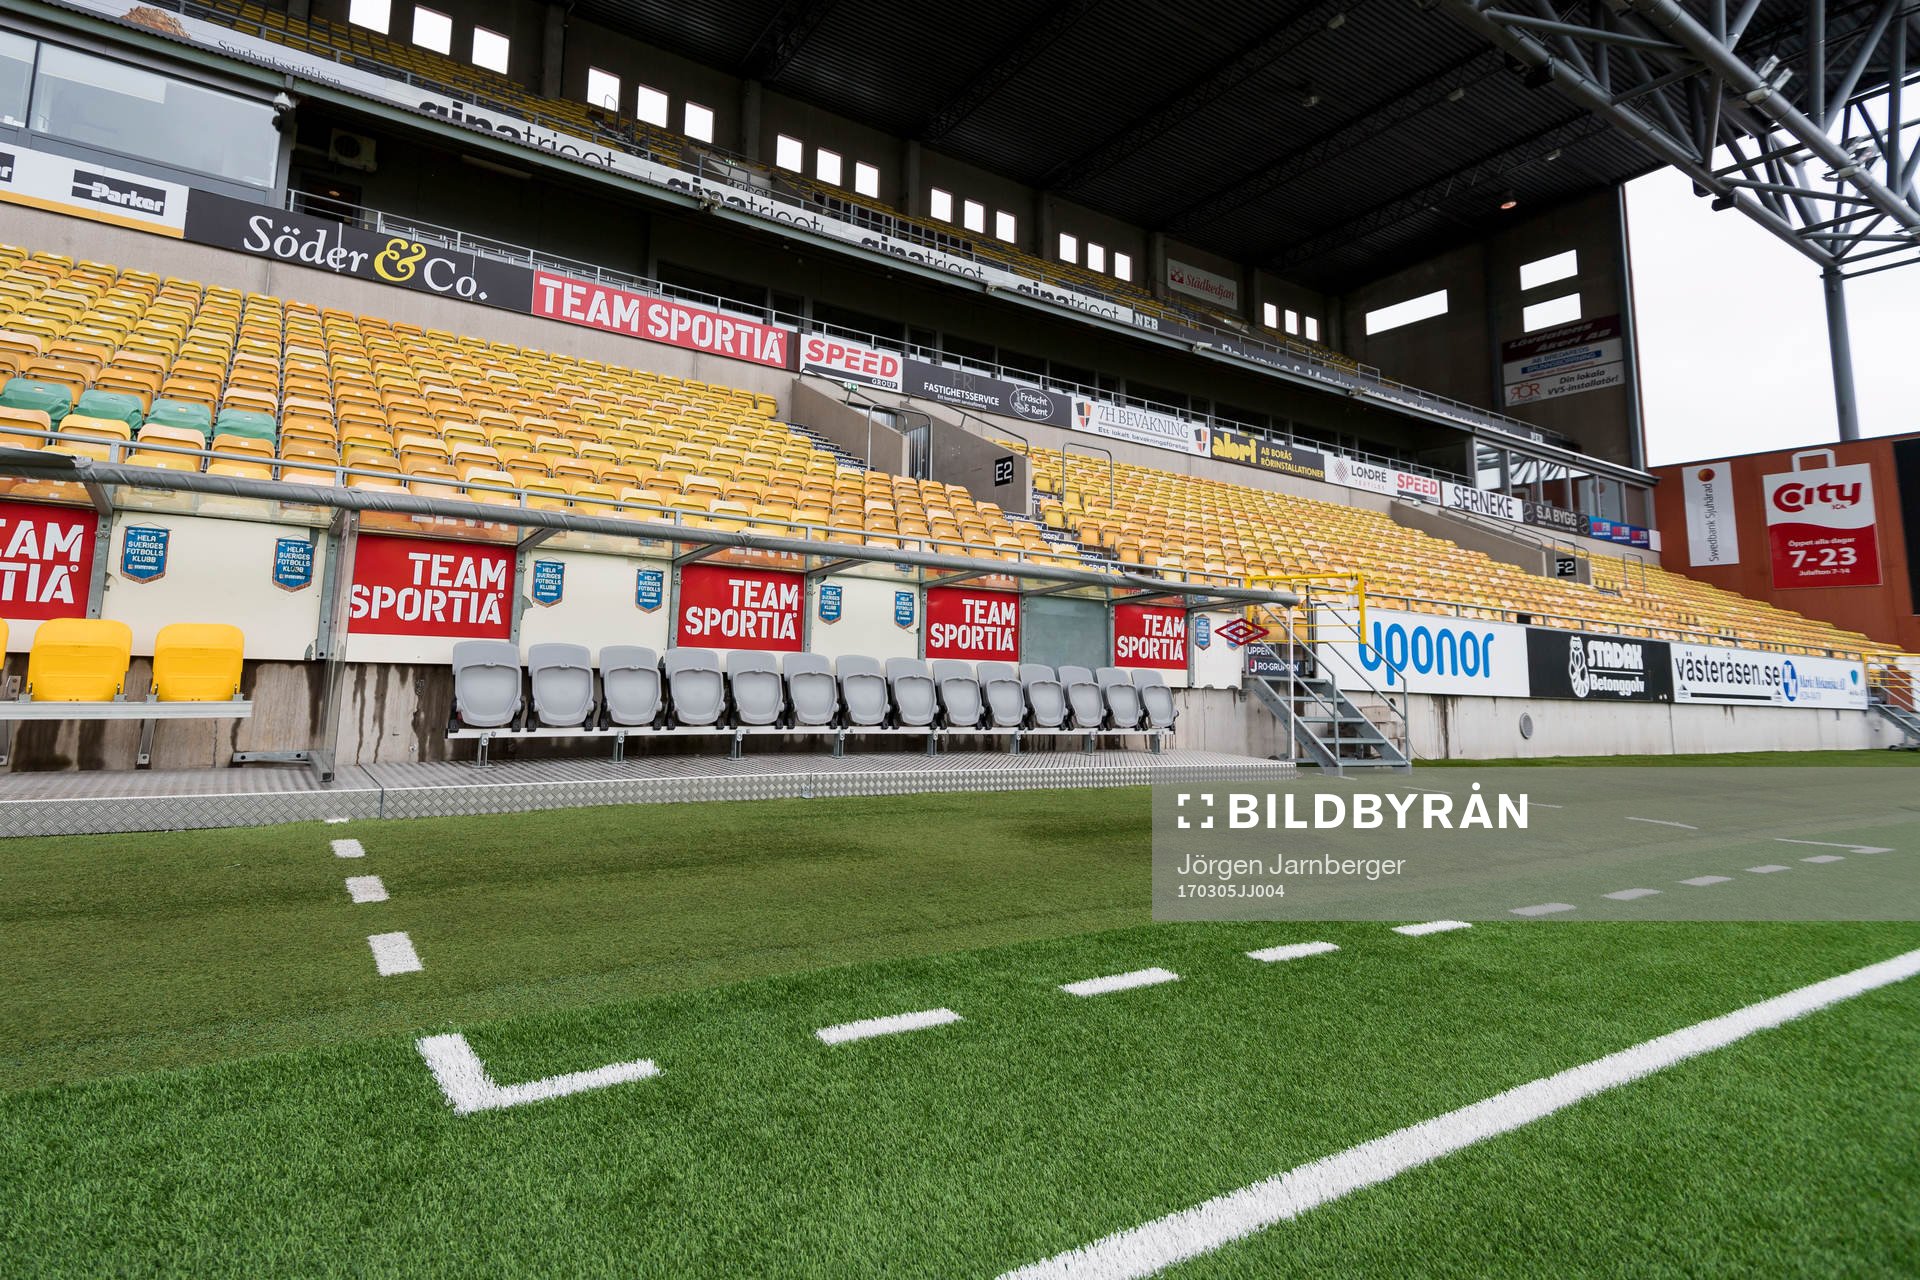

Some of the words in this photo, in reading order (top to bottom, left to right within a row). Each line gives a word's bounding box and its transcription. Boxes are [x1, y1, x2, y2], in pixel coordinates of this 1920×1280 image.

[91, 181, 164, 213] Parker
[243, 215, 368, 273] Söder
[374, 238, 427, 282] &
[423, 257, 488, 301] Co.
[539, 276, 639, 332] TEAM
[647, 303, 784, 364] SPORTIA
[805, 339, 899, 378] SPEED
[872, 378, 897, 389] GROUP
[1560, 375, 1575, 384] Din
[1577, 369, 1605, 381] lokala
[923, 382, 1000, 406] FASTIGHETSSERVICE
[1020, 391, 1048, 406] Fräscht
[1024, 404, 1030, 412] &
[1031, 405, 1048, 417] Rent
[1098, 404, 1116, 423] 7H
[1118, 409, 1189, 439] BEVAKNING
[1098, 426, 1109, 435] Ett
[1112, 429, 1130, 439] lokalt
[1261, 446, 1270, 456] AB
[1271, 448, 1293, 461] BORÅS
[995, 461, 1013, 482] E2
[1261, 457, 1325, 478] RÖRINSTALLATIONER
[1351, 465, 1387, 483] LONDRÉ
[1397, 473, 1438, 496] SPEED
[1453, 485, 1514, 519] SERNEKE
[1702, 483, 1717, 519] Sjuhärad
[1773, 482, 1862, 513] City
[1536, 505, 1552, 521] S.A
[1553, 510, 1577, 527] BYGG
[126, 548, 164, 556] FOTBOLLS
[128, 541, 164, 549] SVERIGES
[1706, 520, 1720, 562] Swedbank
[132, 555, 157, 563] KLUBB
[277, 559, 311, 567] FOTBOLLS
[279, 552, 311, 560] SVERIGES
[1557, 560, 1575, 574] F2
[1788, 547, 1858, 568] 7-23
[408, 552, 507, 590] TEAM
[349, 584, 504, 625] SPORTIA
[728, 578, 799, 611] TEAM
[685, 606, 797, 640] SPORTIA
[962, 599, 1016, 626] TEAM
[930, 622, 1015, 652] SPORTIA
[1142, 614, 1186, 639] TEAM
[1117, 636, 1185, 661] SPORTIA
[1358, 620, 1495, 686] uponor
[1675, 652, 1781, 687] västeråsen.se
[1589, 673, 1645, 696] Betonggolv
